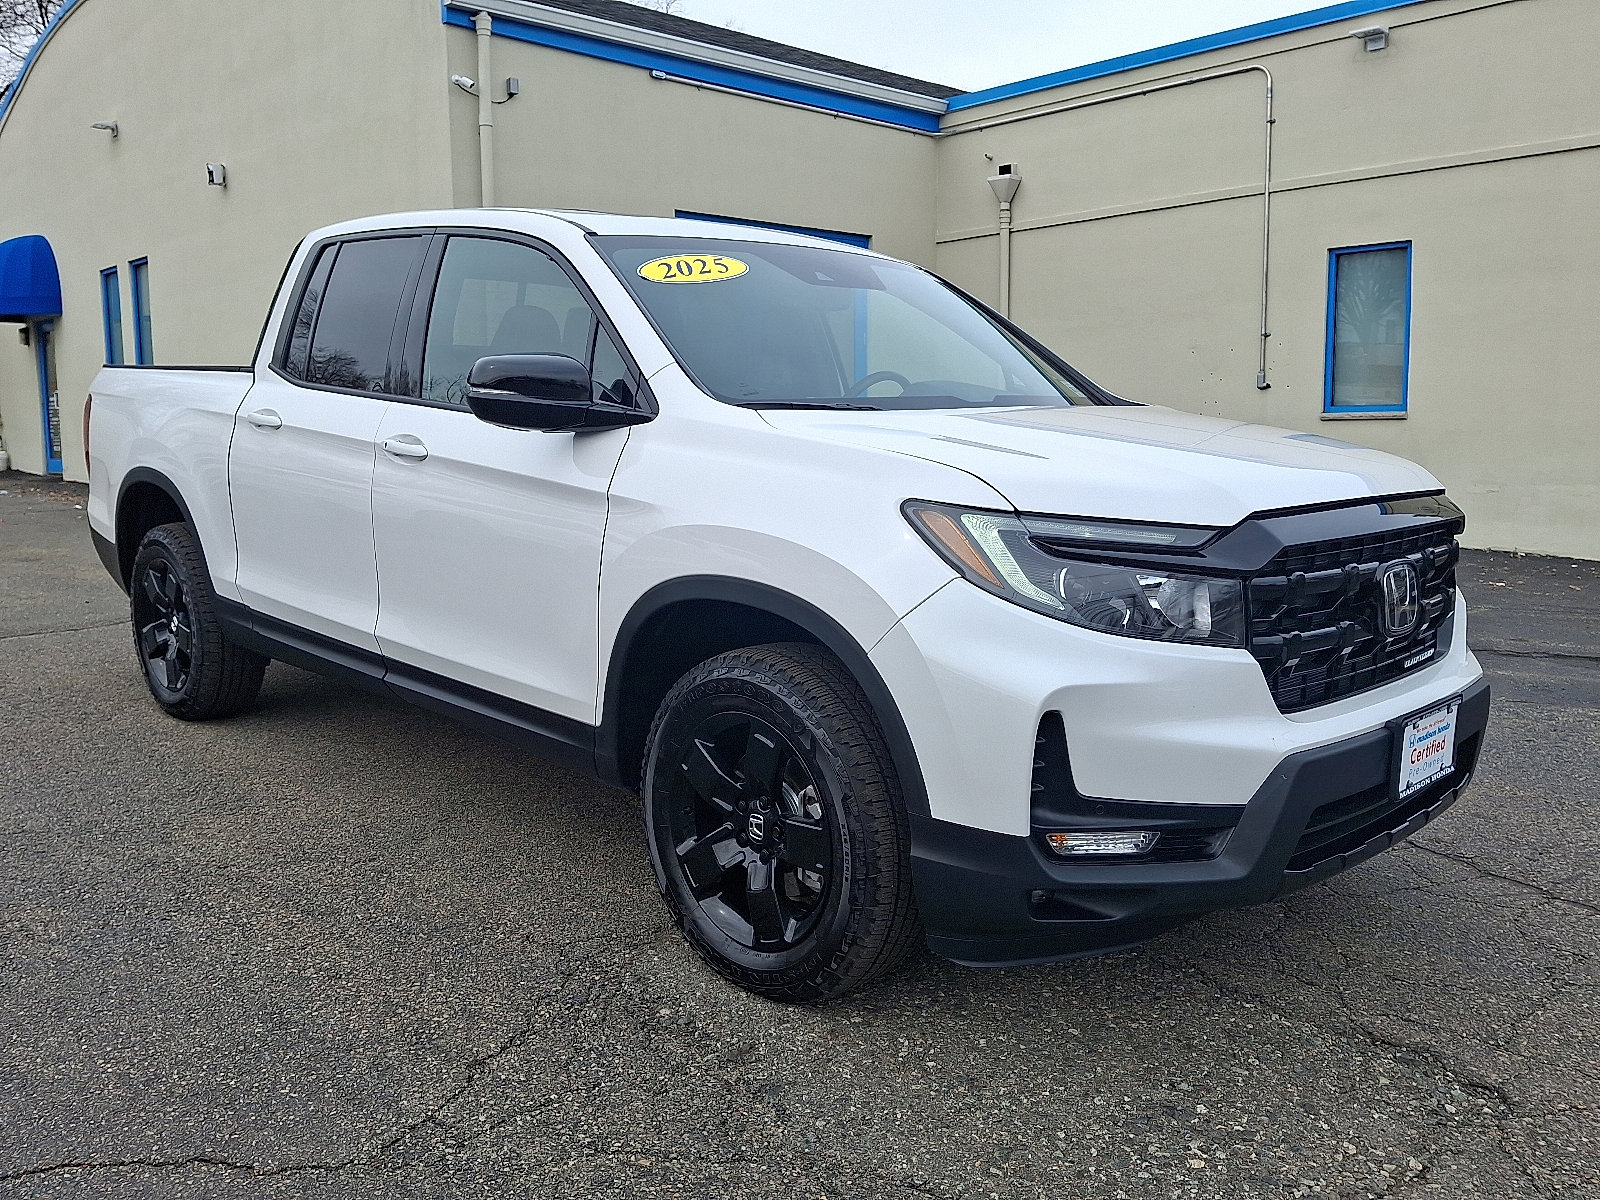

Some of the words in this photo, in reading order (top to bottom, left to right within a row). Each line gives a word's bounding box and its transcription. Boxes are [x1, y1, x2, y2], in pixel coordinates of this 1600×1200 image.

[657, 258, 729, 279] 2025
[1410, 734, 1447, 765] Certified
[1408, 753, 1445, 778] Pre-Owned
[1399, 778, 1431, 800] MADISON
[1431, 765, 1456, 782] HONDA
